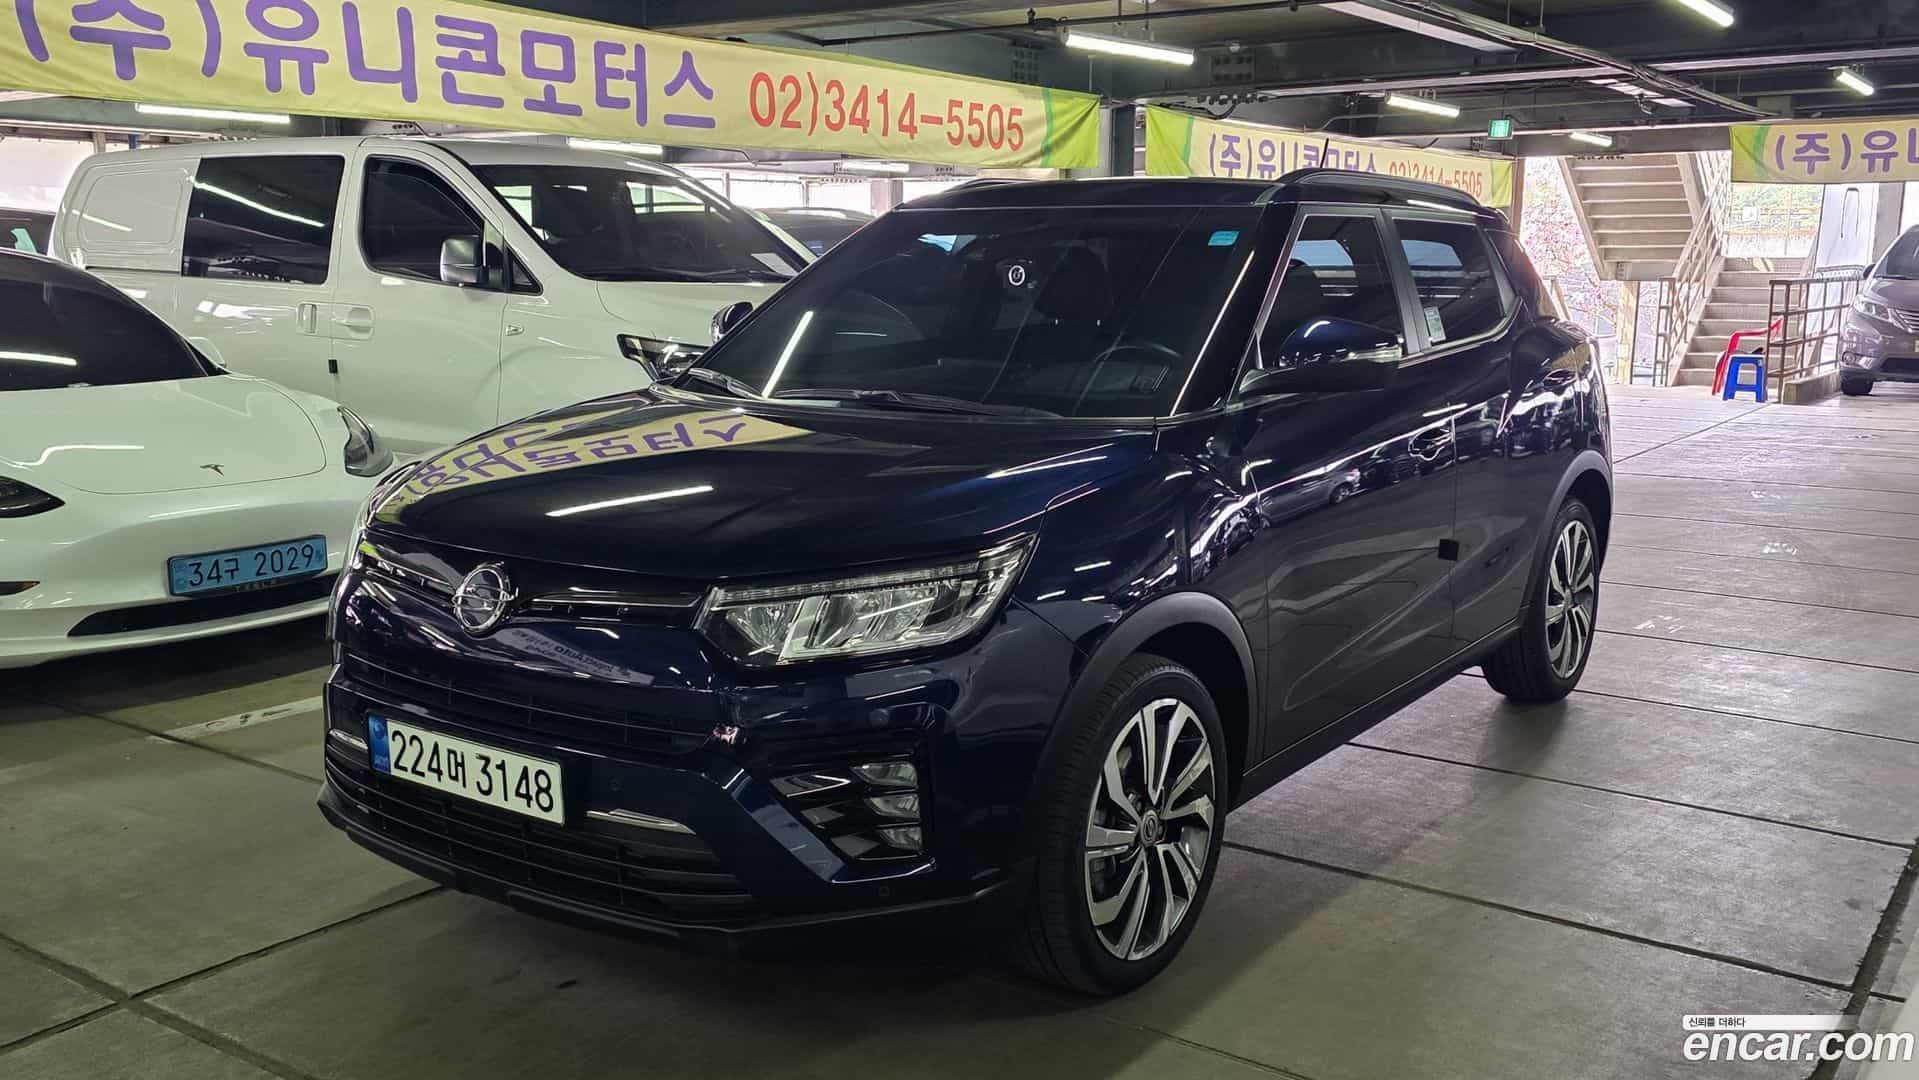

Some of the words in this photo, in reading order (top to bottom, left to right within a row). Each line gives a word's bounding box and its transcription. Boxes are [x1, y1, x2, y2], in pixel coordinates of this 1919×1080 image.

[749, 71, 1025, 151] 02)3414-5505
[188, 557, 240, 587] 34구
[254, 543, 315, 577] 2029
[391, 730, 467, 789] 224머
[475, 752, 555, 813] 3148
